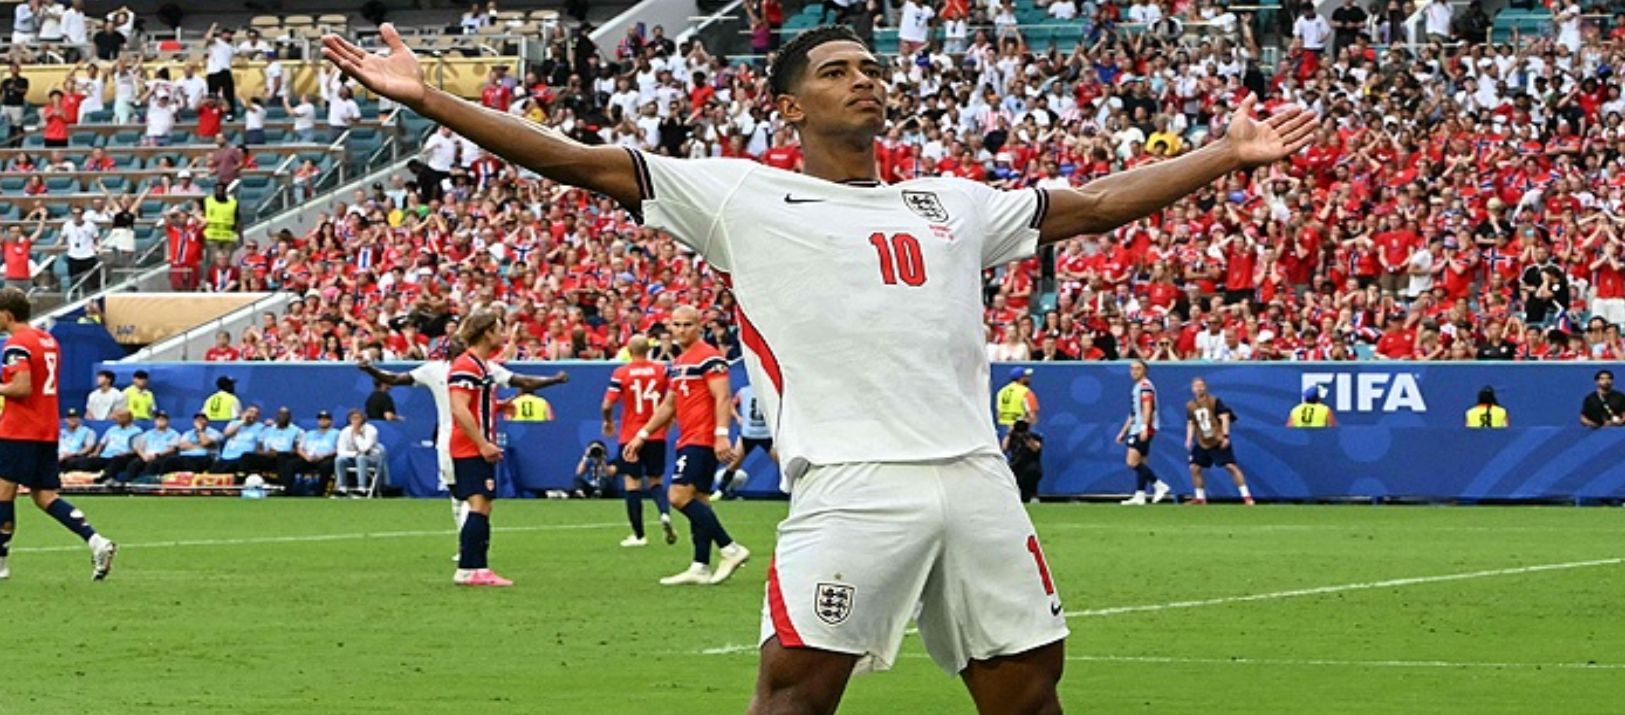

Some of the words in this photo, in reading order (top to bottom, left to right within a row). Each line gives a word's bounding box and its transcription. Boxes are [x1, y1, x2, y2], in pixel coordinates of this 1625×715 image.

[868, 232, 927, 287] 10
[630, 379, 661, 414] 14
[1301, 373, 1426, 411] FIFA
